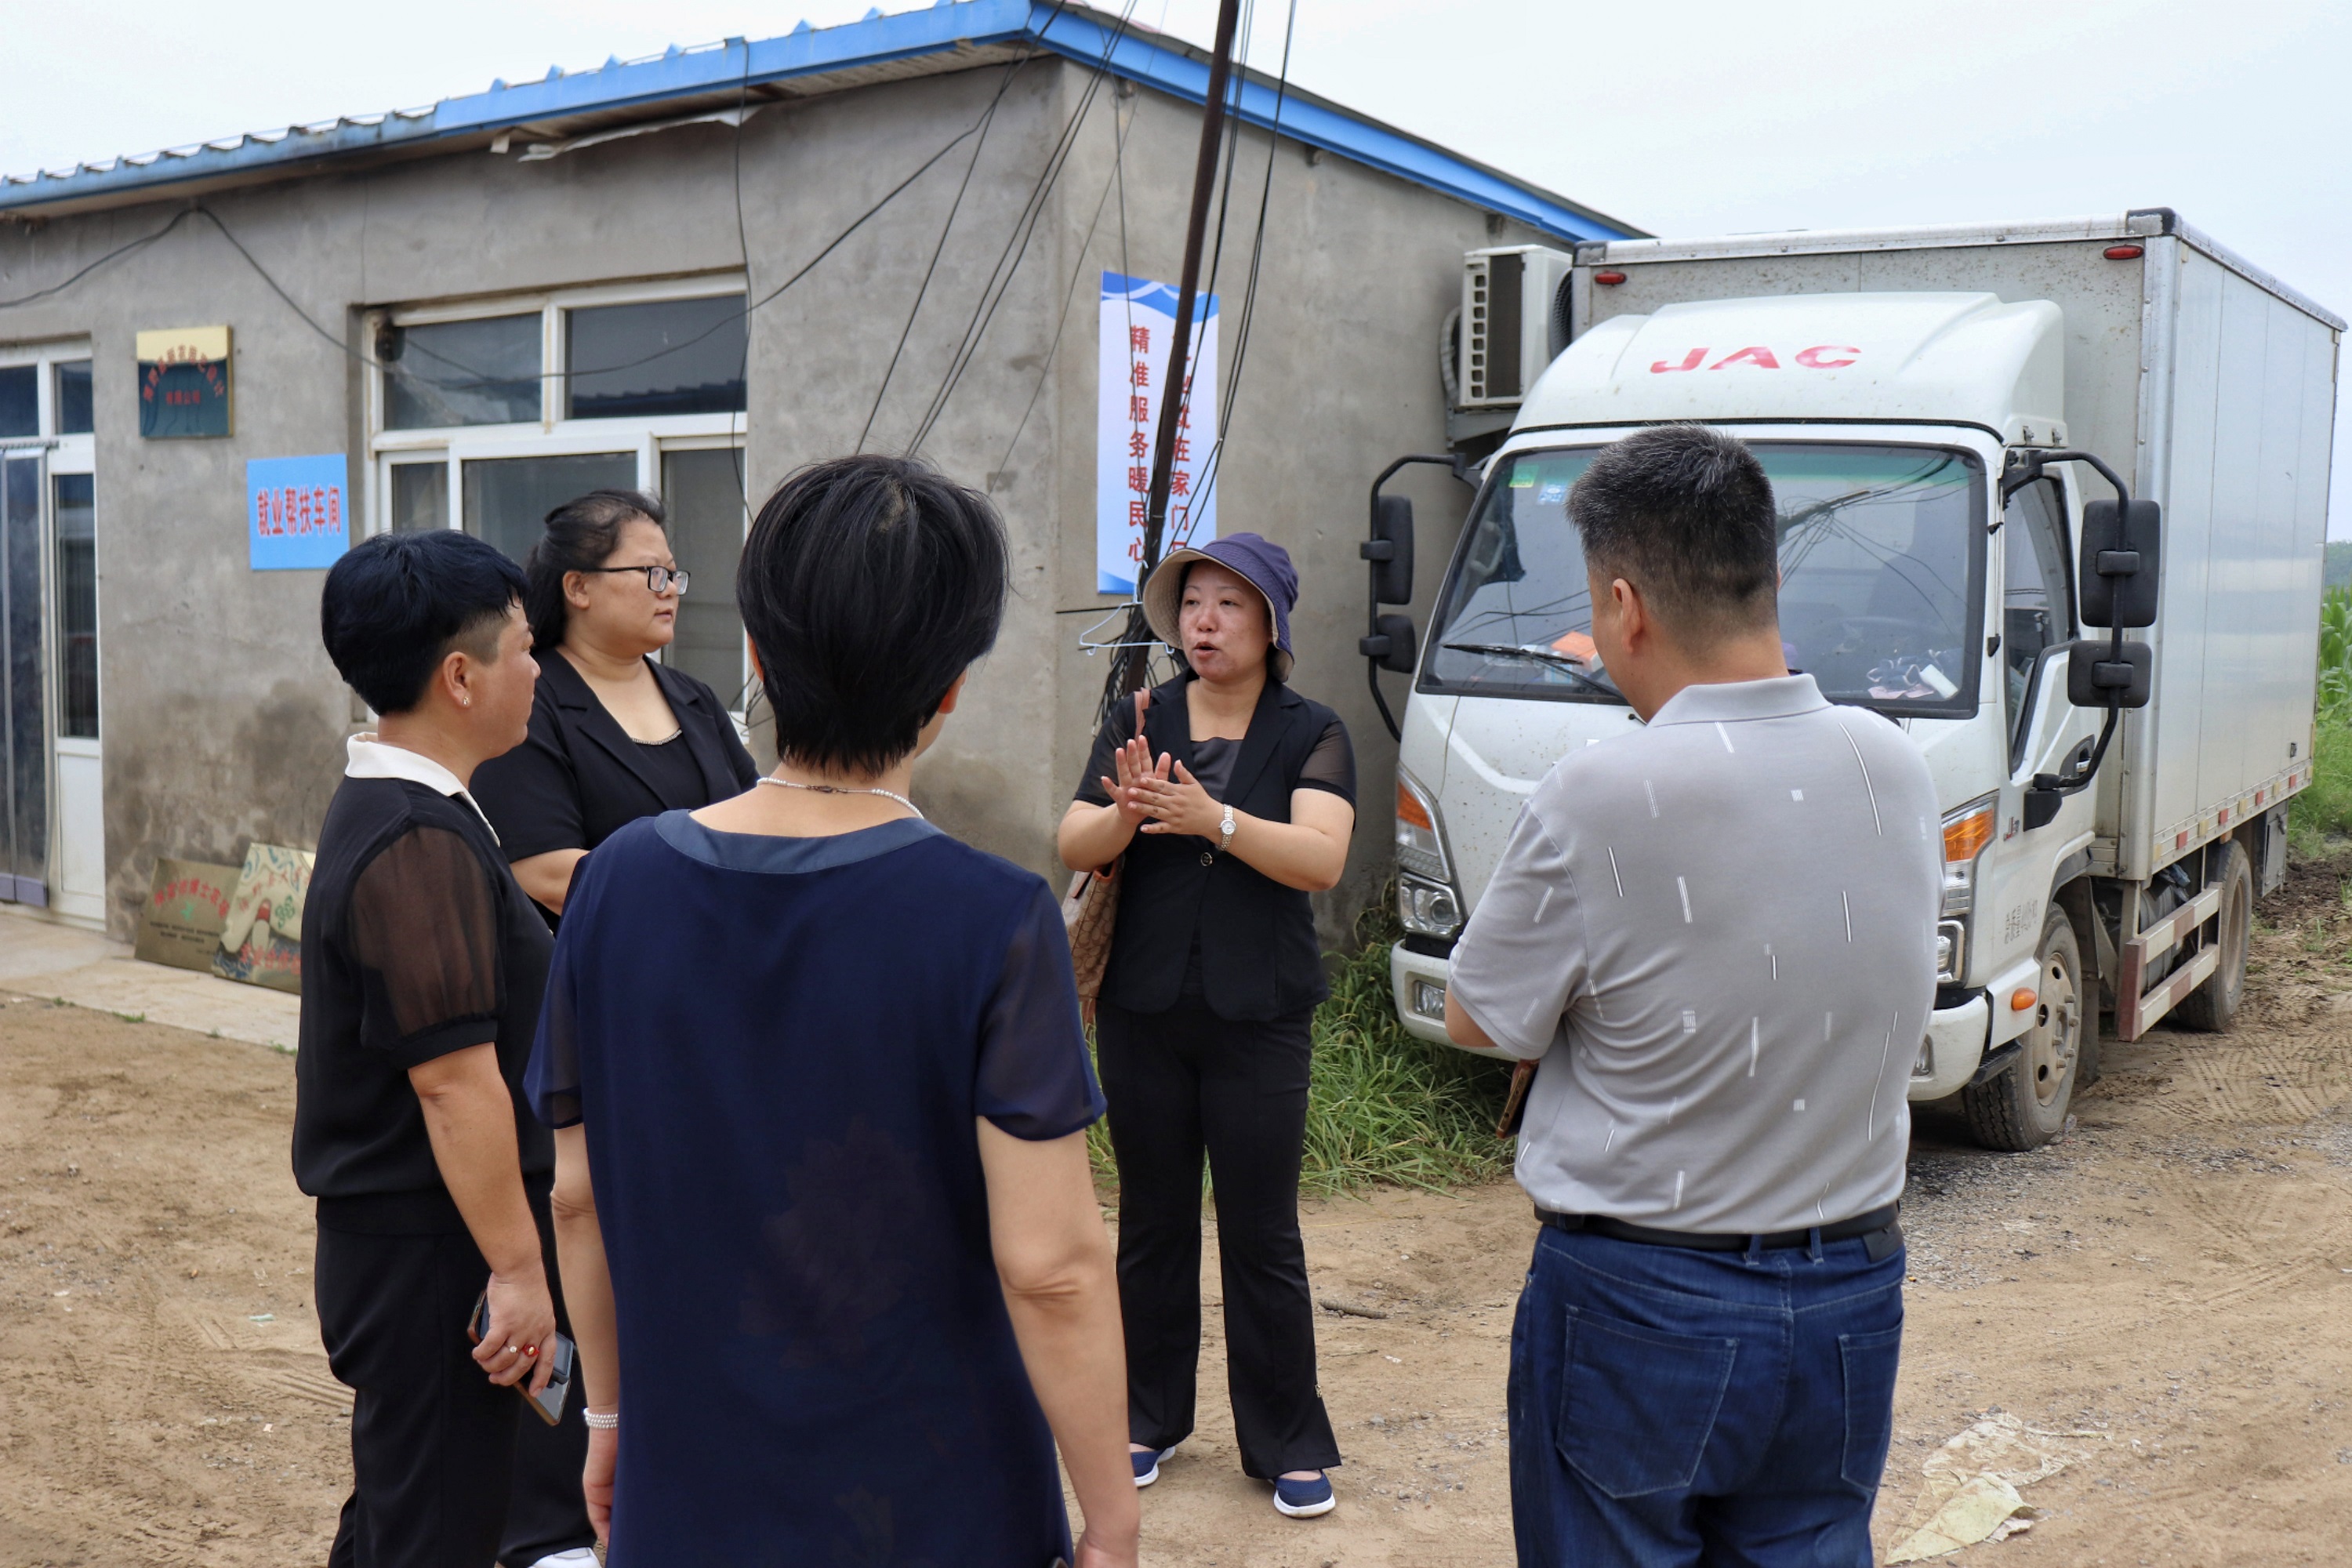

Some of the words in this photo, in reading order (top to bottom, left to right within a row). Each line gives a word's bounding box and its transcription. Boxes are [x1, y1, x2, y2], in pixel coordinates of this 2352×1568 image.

[1650, 345, 1862, 374] JAC
[1127, 325, 1150, 563] 精准服务暖民心
[256, 485, 341, 536] 就业帮扶车间
